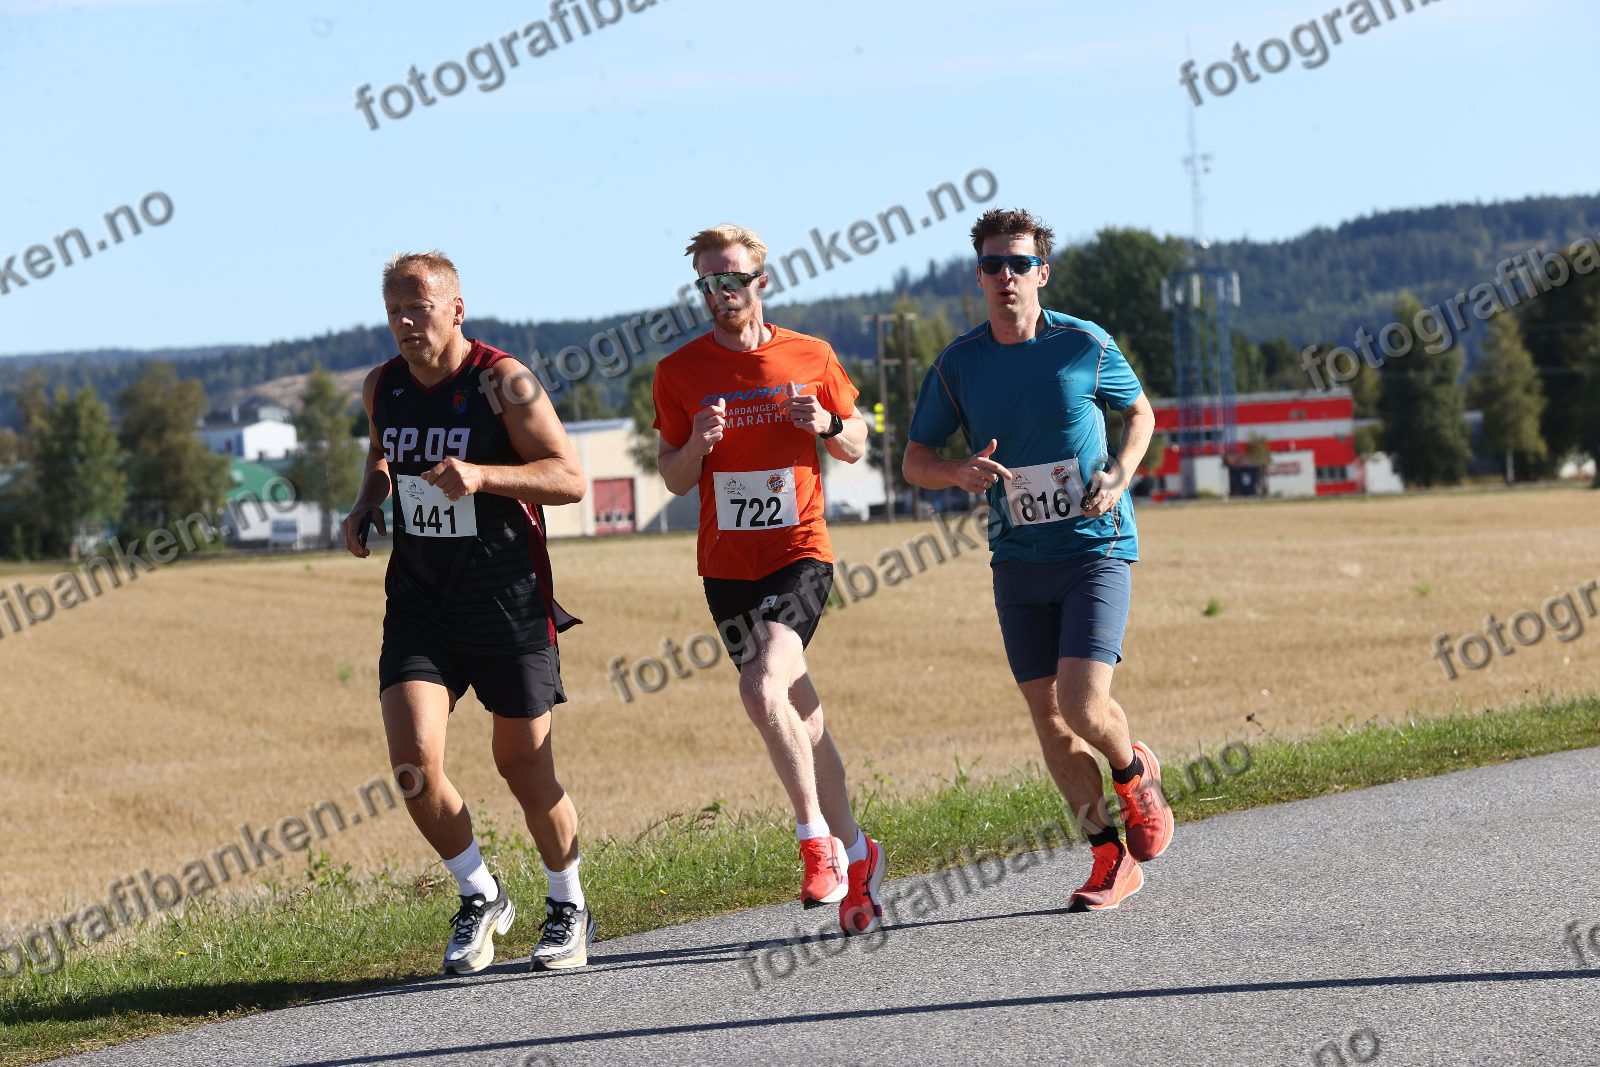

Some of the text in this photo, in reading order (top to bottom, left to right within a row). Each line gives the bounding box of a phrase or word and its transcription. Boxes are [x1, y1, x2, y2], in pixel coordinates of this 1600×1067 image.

[382, 427, 470, 463] SP.09
[412, 504, 457, 535] 441
[729, 496, 783, 528] 722
[1020, 487, 1071, 522] 816
